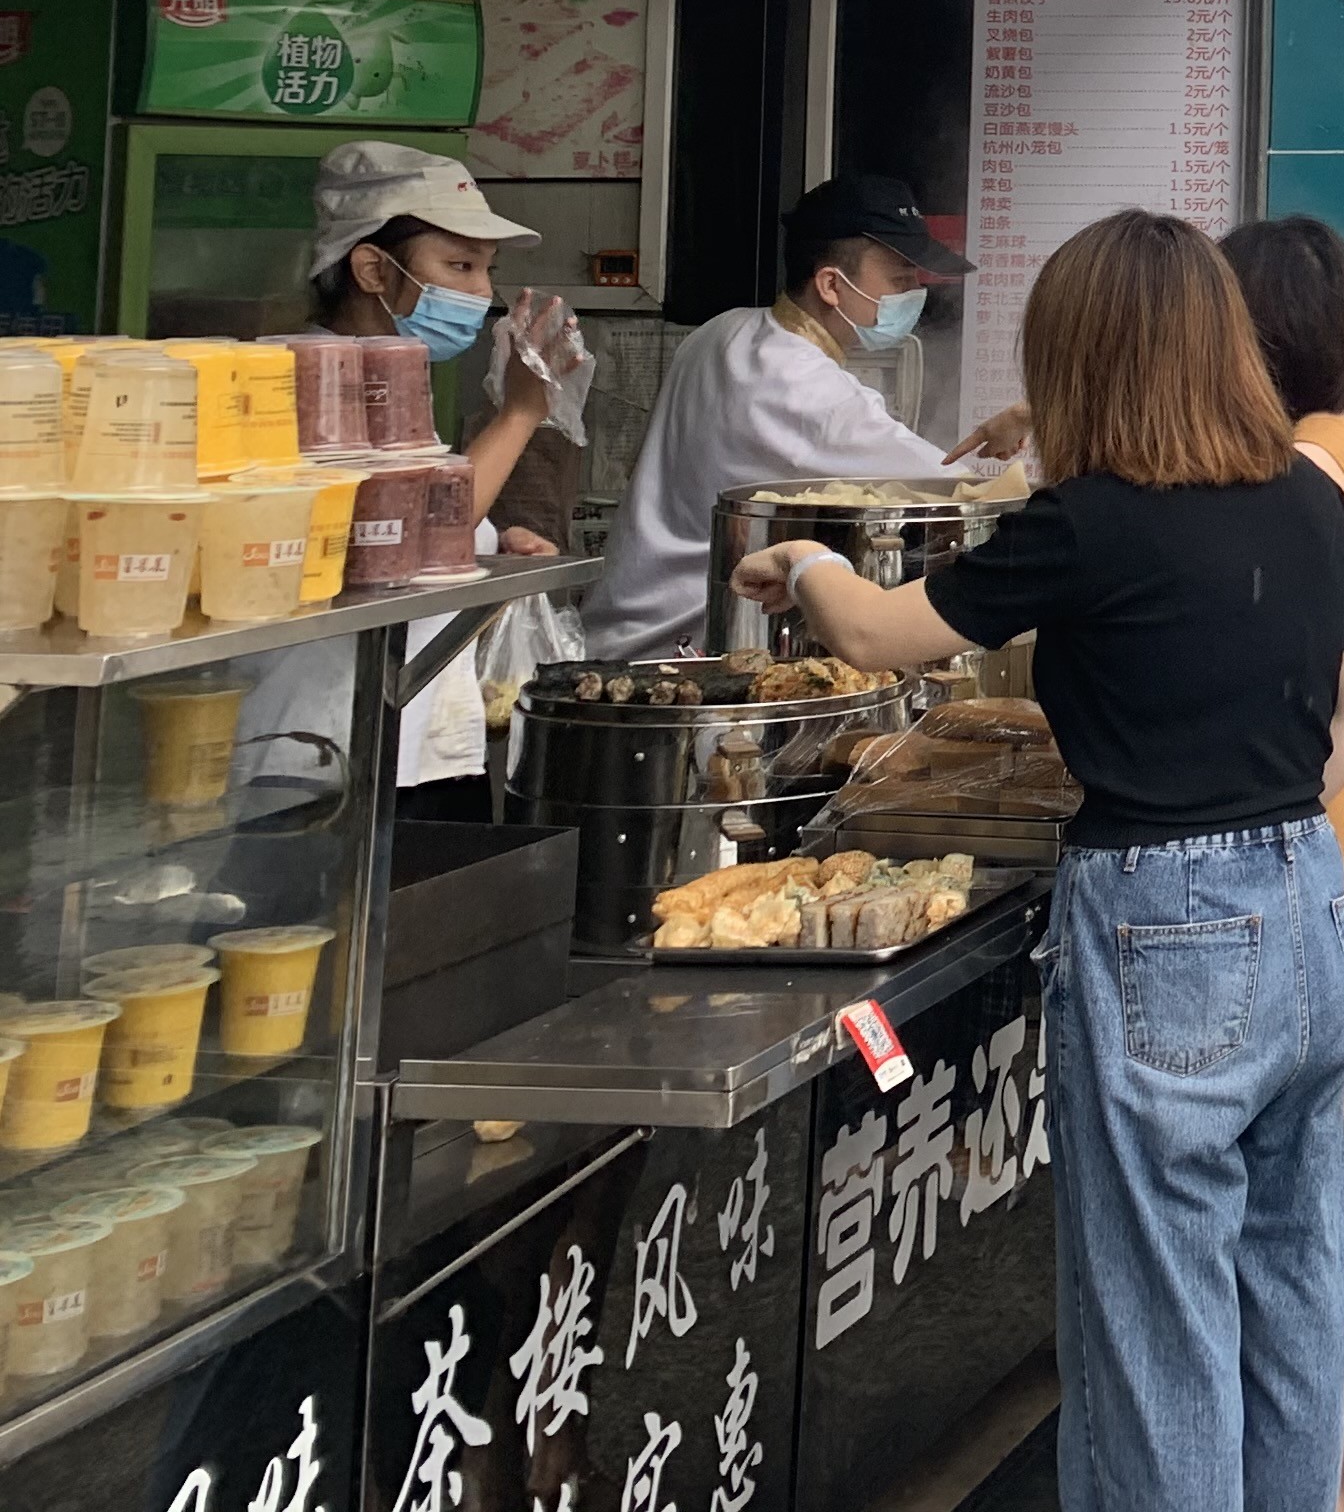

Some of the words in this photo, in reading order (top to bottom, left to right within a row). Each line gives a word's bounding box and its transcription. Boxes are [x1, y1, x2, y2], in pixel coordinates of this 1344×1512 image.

[986, 10, 1034, 24] 生肉包
[1186, 10, 1233, 24] 2元/个
[986, 28, 1033, 43] 叉烧包
[1185, 28, 1233, 43] 2元/个
[276, 33, 342, 70] 植物
[985, 47, 1033, 61] 紫薯包
[1185, 47, 1231, 61] 2元/个
[984, 66, 1033, 80] 奶黄包
[1184, 66, 1231, 80] 2元/个
[271, 70, 339, 105] 活力
[984, 84, 1032, 99] 流沙包
[1184, 84, 1230, 99] 2元/个
[983, 103, 1032, 117] 豆沙包
[1183, 103, 1230, 118] 2元/个
[983, 122, 1080, 137] 白面燕麦馒头
[1169, 122, 1229, 136] 1.5元/个
[983, 141, 1063, 155] 杭州小笼包
[1183, 141, 1230, 155] 5元/笼
[982, 159, 1014, 173] 肉包
[1170, 159, 1231, 174] 1.5元/个
[981, 178, 1013, 192] 菜包
[1170, 178, 1230, 193] 1.5元/个
[980, 197, 1013, 211] 烧卖
[1169, 197, 1230, 212] 1.5元/个
[979, 216, 1011, 231] 油条
[979, 235, 1027, 249] 芝麻球
[978, 254, 1051, 268] 荷香糯米
[976, 291, 1025, 306] 东北玉
